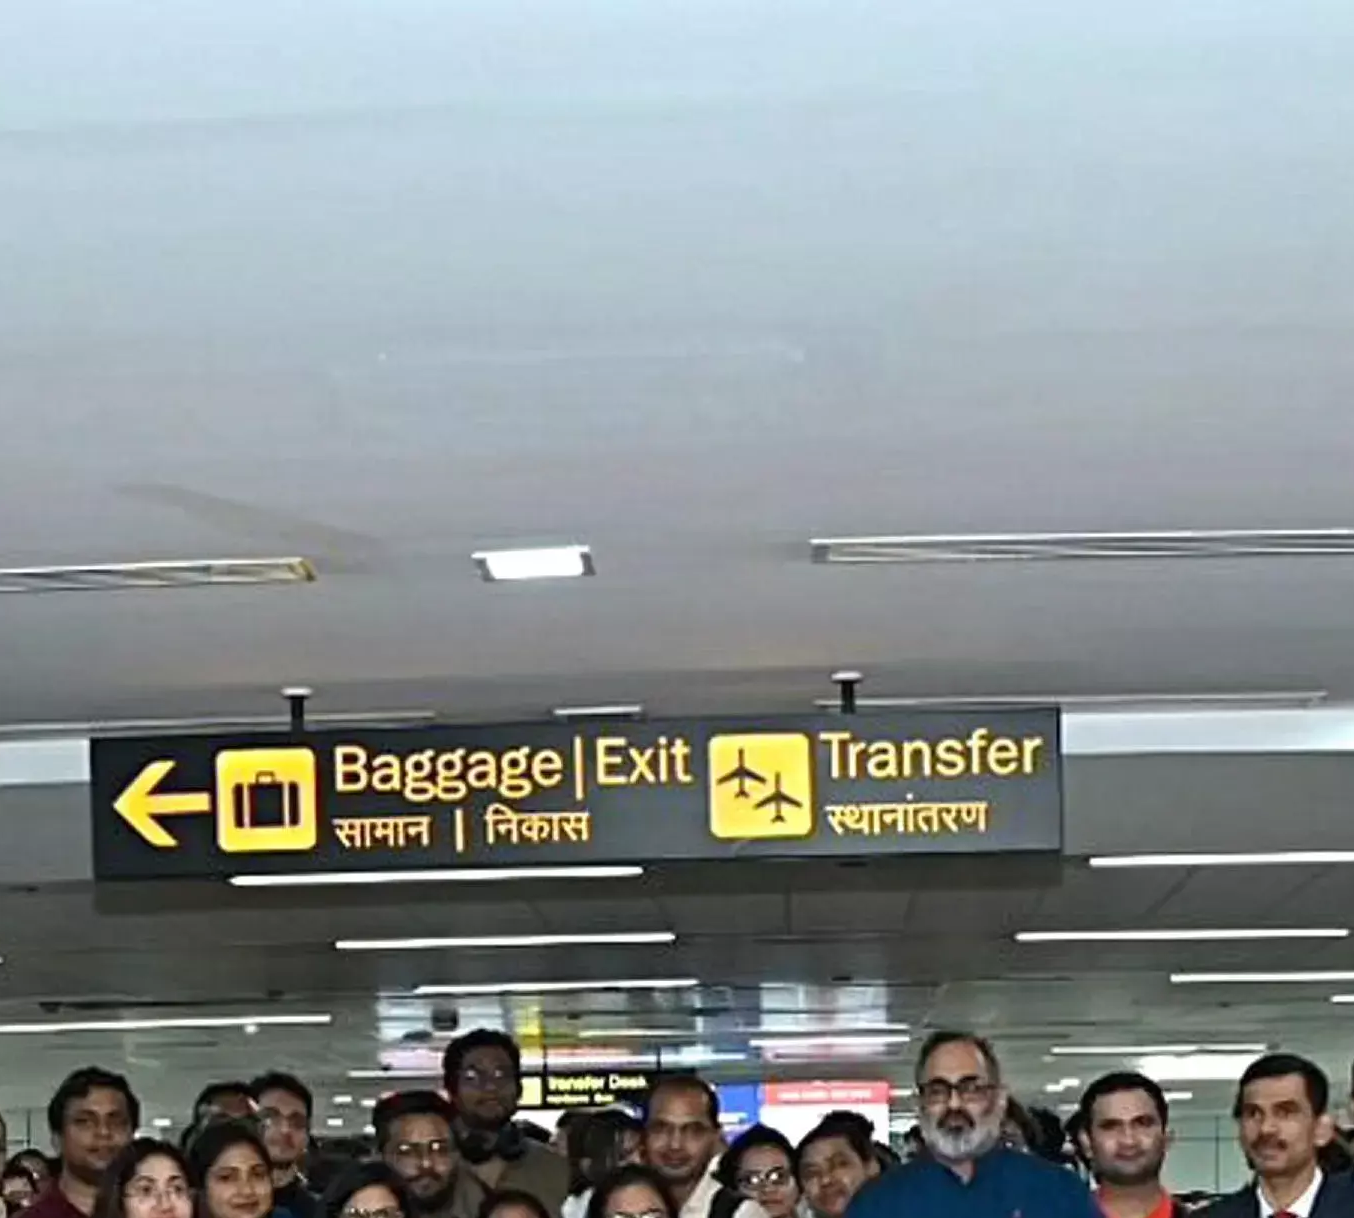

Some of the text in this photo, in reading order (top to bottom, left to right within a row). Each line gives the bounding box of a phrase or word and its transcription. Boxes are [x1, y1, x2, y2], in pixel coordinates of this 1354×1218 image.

[334, 735, 692, 801] Baggage Exit
[819, 728, 1043, 780] Transfer
[333, 803, 590, 849] सामान निकास
[824, 794, 989, 835] स्थानांतरण
